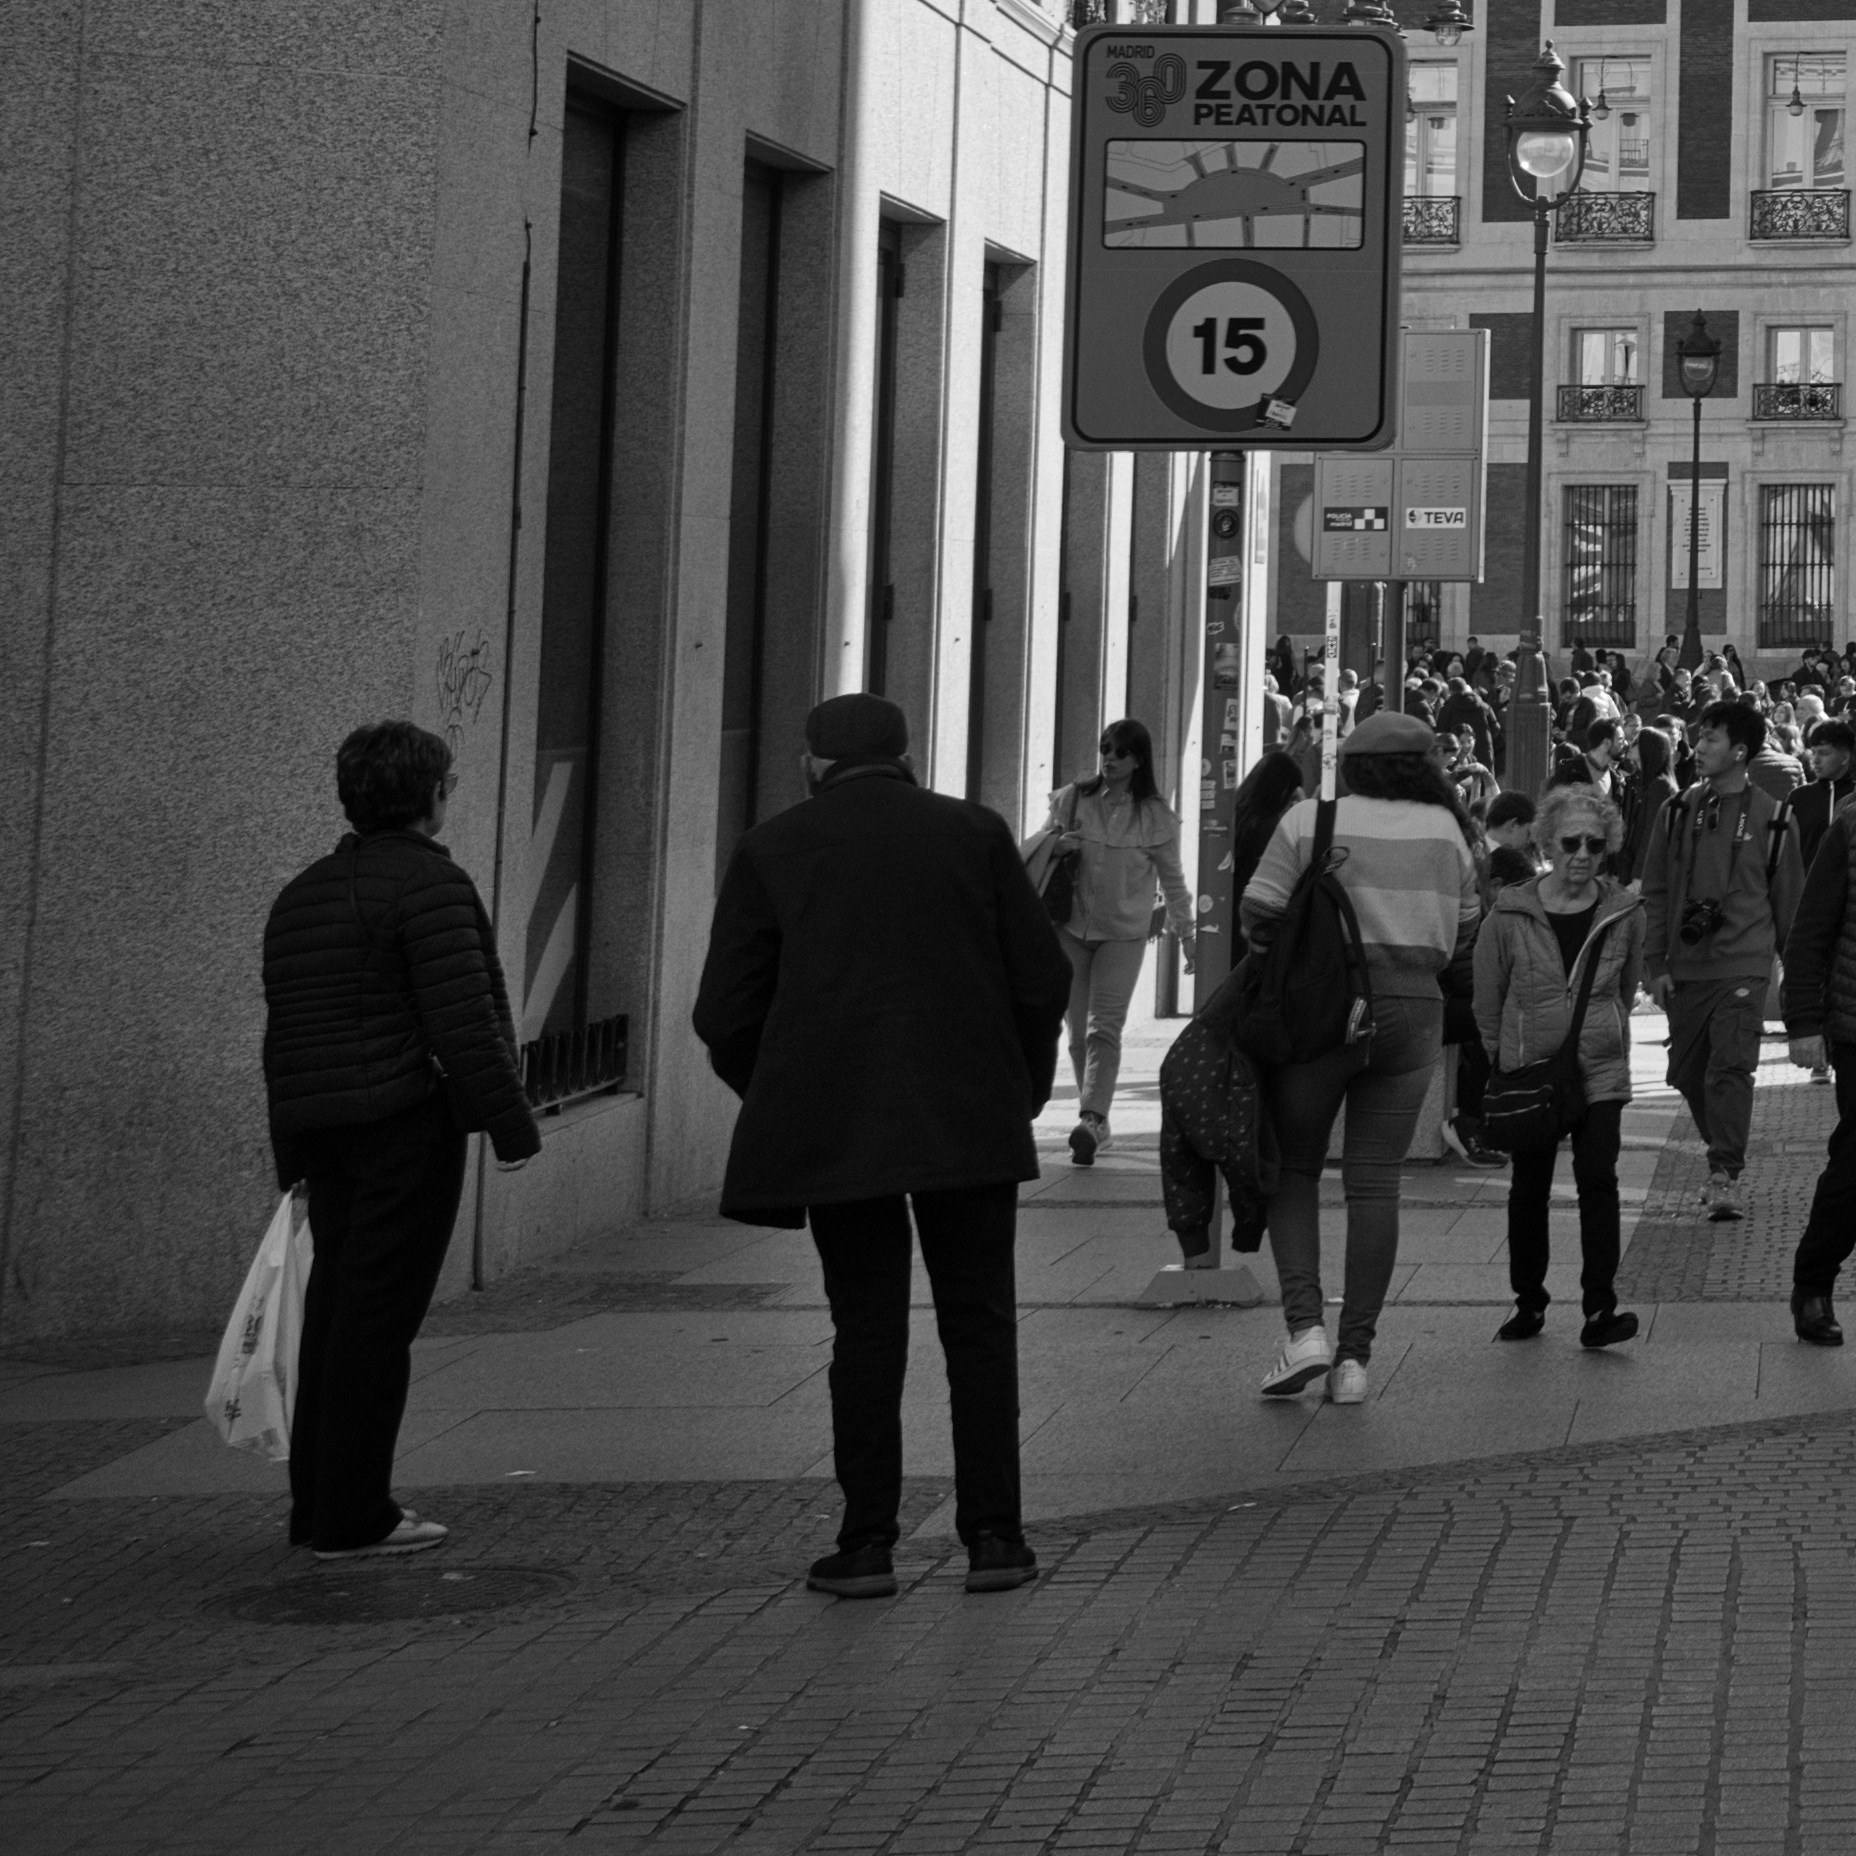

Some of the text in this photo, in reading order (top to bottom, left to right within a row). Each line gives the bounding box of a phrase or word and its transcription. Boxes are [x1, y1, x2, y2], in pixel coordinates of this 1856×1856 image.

[1106, 45, 1155, 59] MADRID
[1106, 53, 1187, 127] 360
[1195, 60, 1367, 101] ZONA
[1194, 104, 1367, 127] PEATONAL
[1192, 317, 1267, 376] 15
[1424, 512, 1465, 524] TEVA
